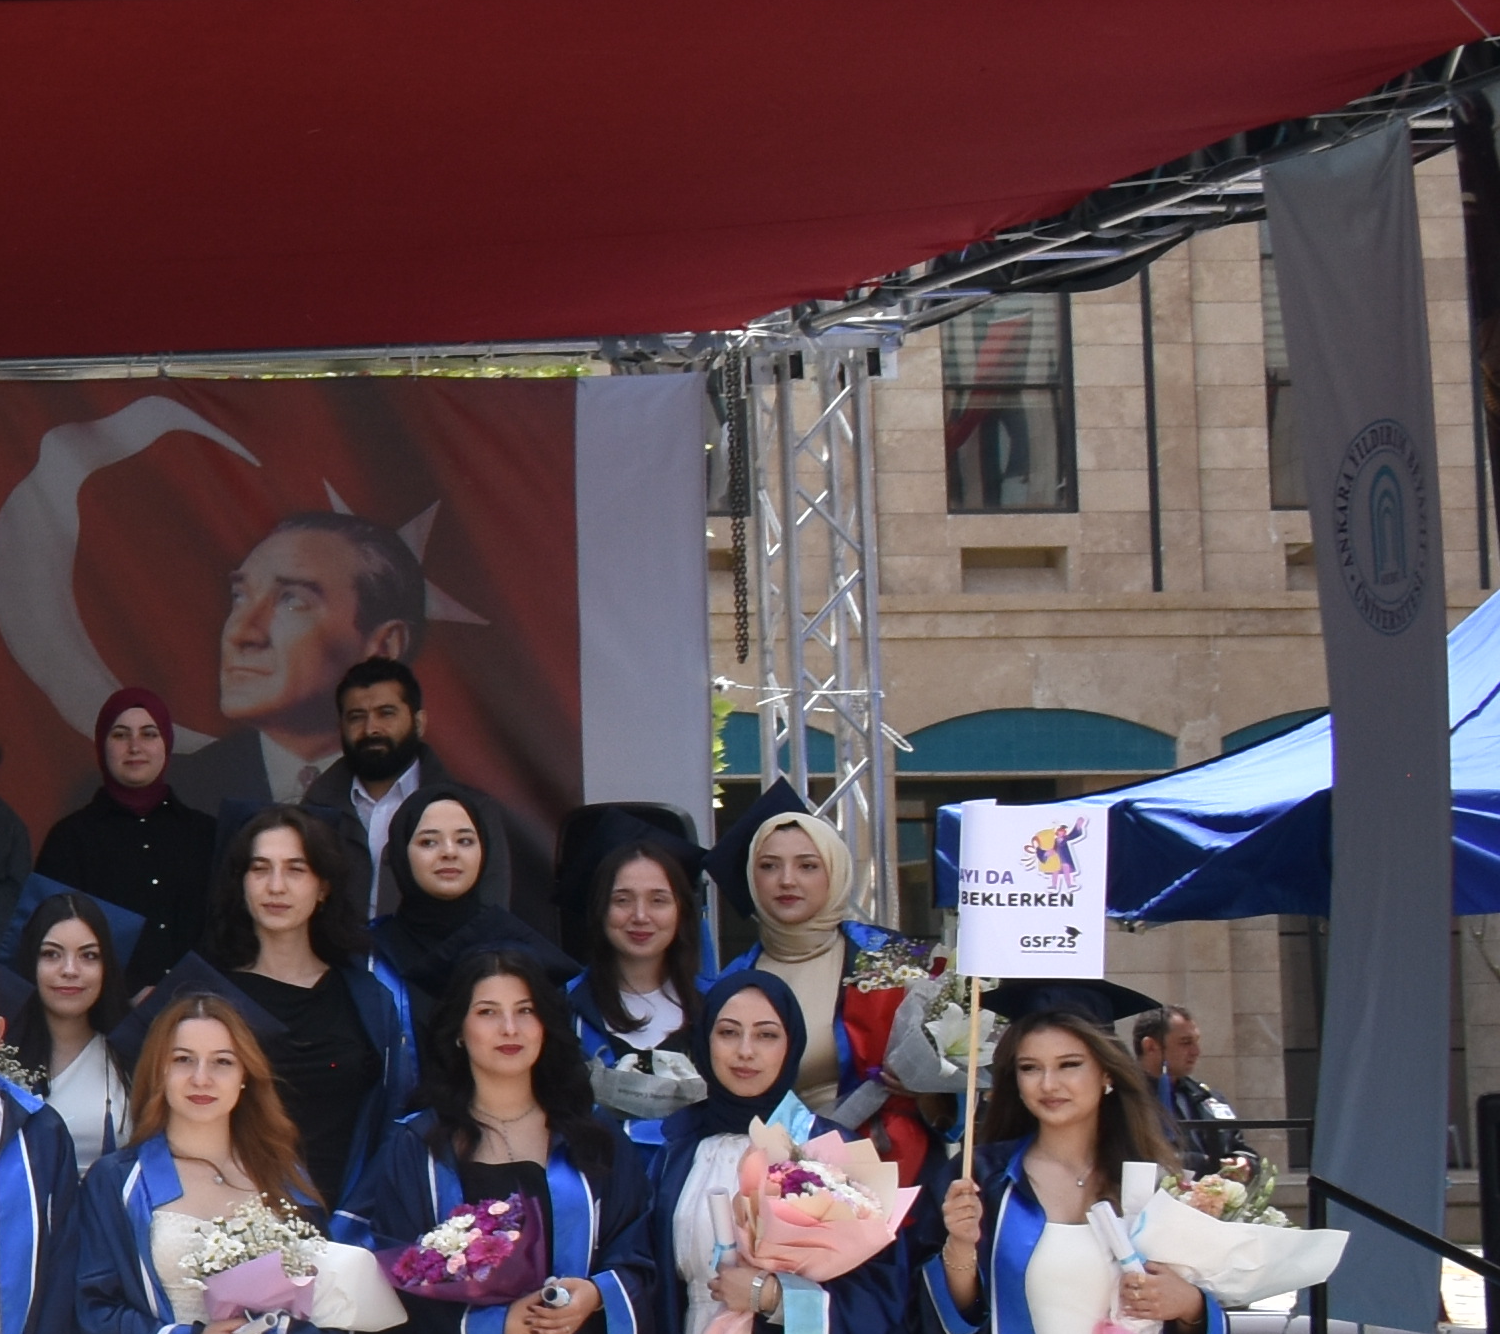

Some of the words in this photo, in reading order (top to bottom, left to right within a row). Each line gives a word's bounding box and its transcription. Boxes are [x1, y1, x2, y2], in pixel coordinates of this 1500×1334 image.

[986, 870, 1014, 885] DA
[961, 891, 1074, 908] BEKLERKEN
[1020, 935, 1077, 949] GSF'25
